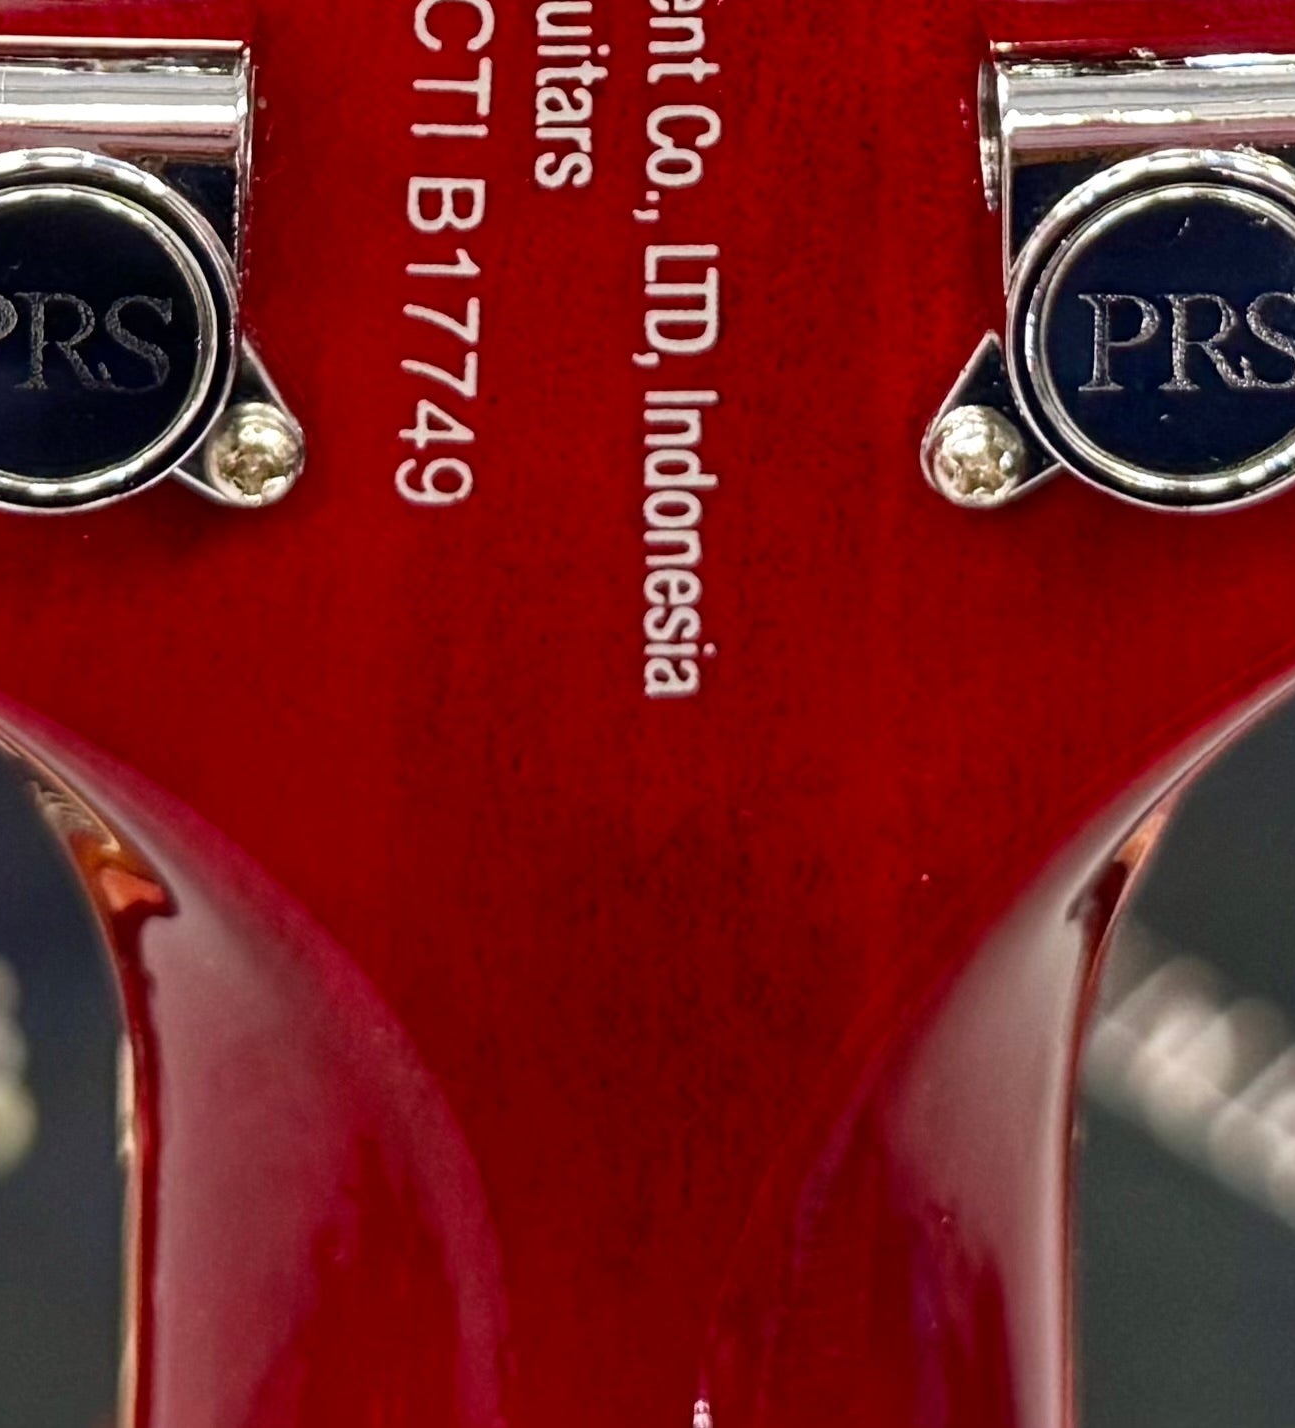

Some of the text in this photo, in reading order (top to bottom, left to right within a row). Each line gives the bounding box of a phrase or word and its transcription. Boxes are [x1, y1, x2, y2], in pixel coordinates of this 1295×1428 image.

[631, 103, 722, 222] Co.,
[393, 175, 487, 506] B17749
[631, 242, 720, 367] LTD,
[641, 389, 719, 698] Indonesia
